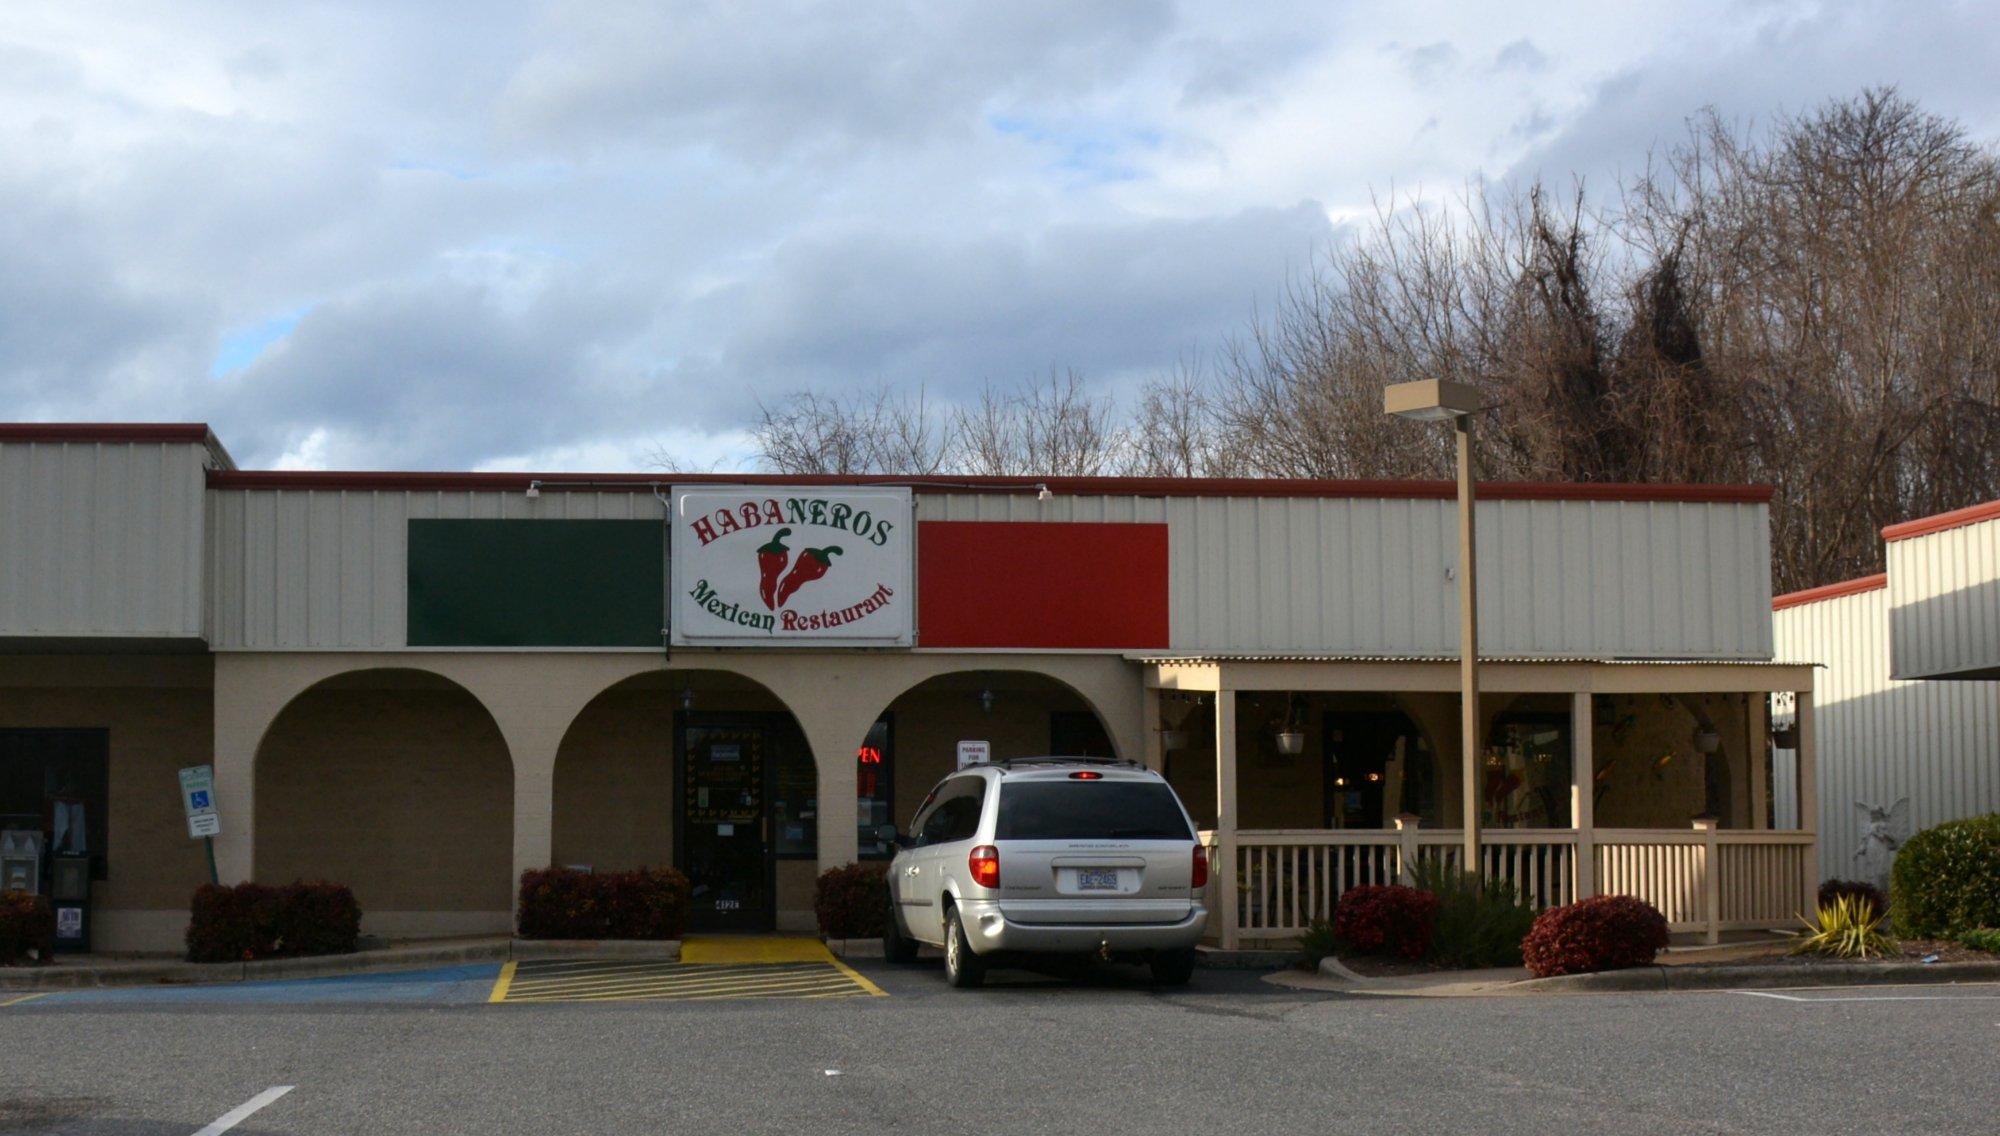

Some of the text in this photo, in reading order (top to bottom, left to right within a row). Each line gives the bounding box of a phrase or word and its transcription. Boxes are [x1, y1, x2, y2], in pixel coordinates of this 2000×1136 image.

[690, 498, 894, 546] HABANEROS
[688, 579, 894, 634] Mexican Restaurant
[858, 747, 881, 763] PEN
